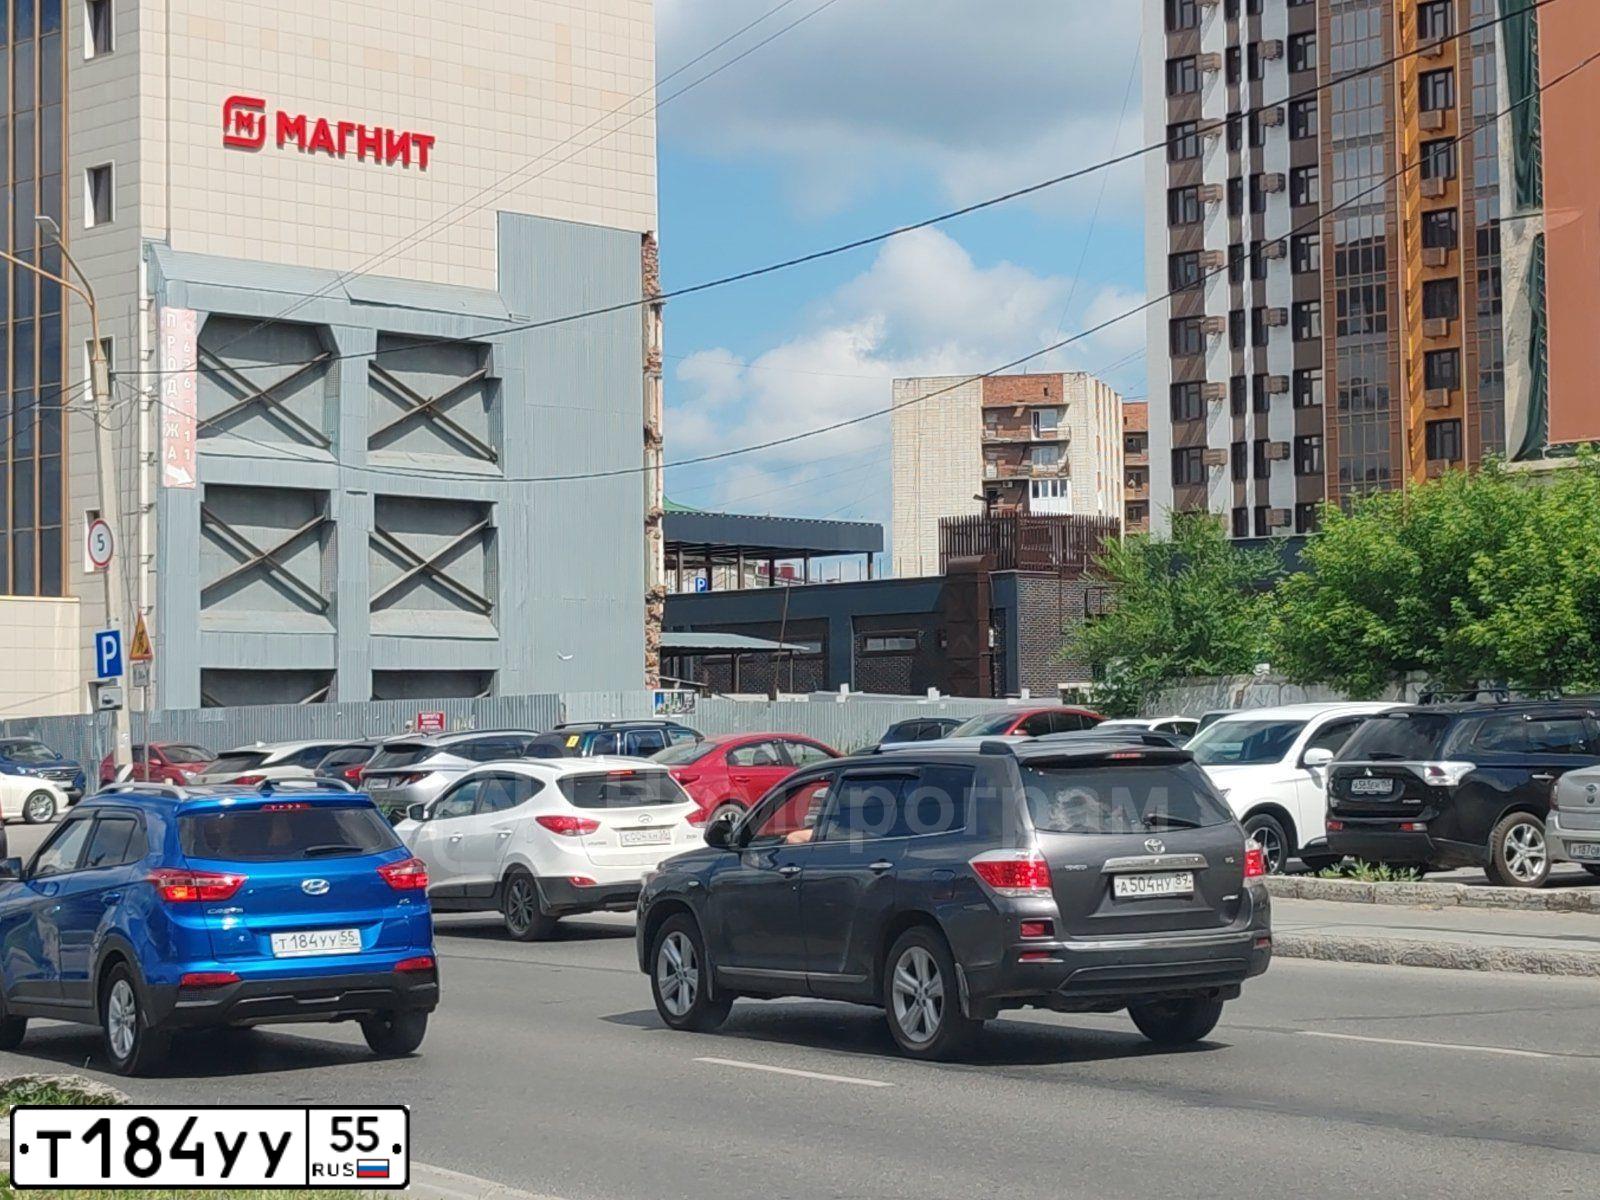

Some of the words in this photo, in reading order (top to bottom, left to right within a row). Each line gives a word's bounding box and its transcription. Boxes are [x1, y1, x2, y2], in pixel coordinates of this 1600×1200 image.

[276, 110, 435, 171] МАГНИТ
[166, 313, 179, 460] ПРОДАЖА
[96, 533, 106, 552] 5
[102, 635, 117, 674] P
[278, 931, 336, 950] Т184УУ
